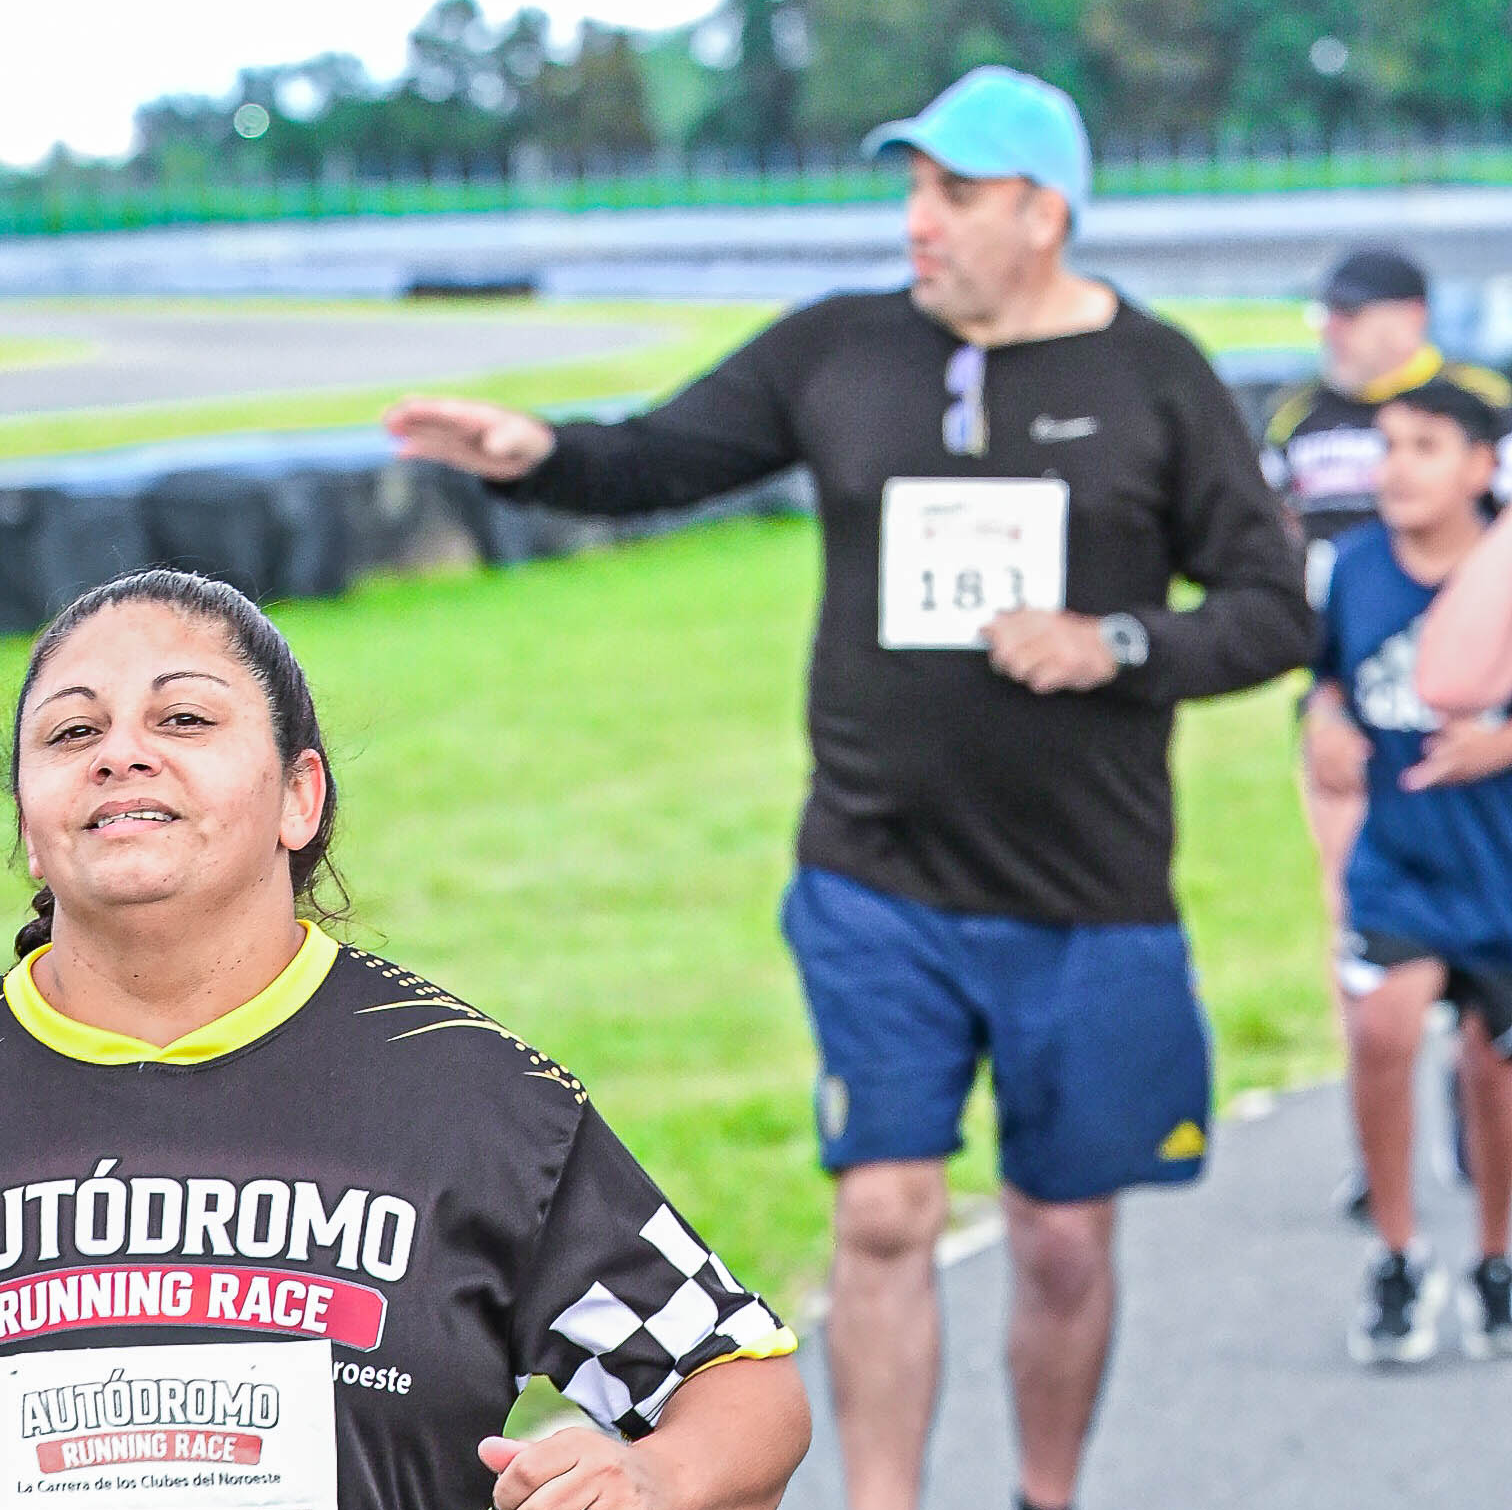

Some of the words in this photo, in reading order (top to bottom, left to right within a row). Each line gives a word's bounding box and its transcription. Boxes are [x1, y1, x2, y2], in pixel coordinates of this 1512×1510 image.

[208, 1272, 334, 1334] RACE
[333, 1360, 412, 1395] roeste
[22, 1368, 280, 1439] AUTÓDROMO
[60, 1432, 168, 1470] RUNNING
[175, 1431, 239, 1463] RACE
[17, 1480, 33, 1493] La
[37, 1480, 90, 1493] Carrera
[94, 1476, 112, 1490] de
[117, 1476, 137, 1490] los
[141, 1474, 189, 1489] Clubes
[193, 1472, 215, 1487] del
[218, 1472, 281, 1487] Noroeste
